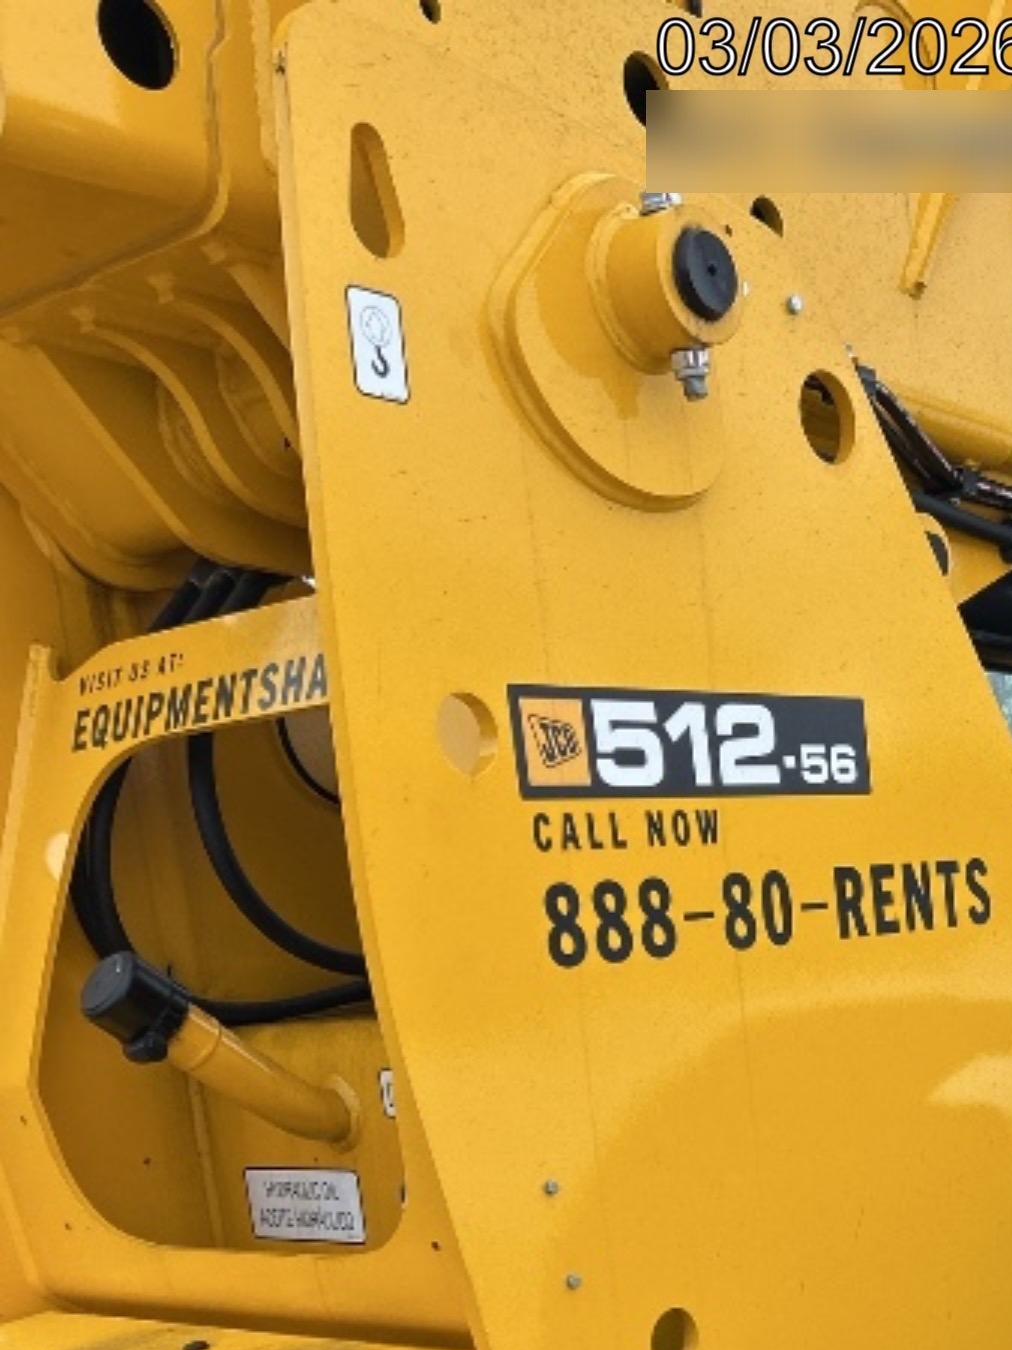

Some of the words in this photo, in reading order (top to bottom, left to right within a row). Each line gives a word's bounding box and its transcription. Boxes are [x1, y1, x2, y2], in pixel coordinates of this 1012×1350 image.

[79, 665, 121, 697] VISIT
[533, 811, 628, 852] CALL
[646, 809, 720, 847] NOW
[543, 857, 992, 968] 888-80-RENTS
